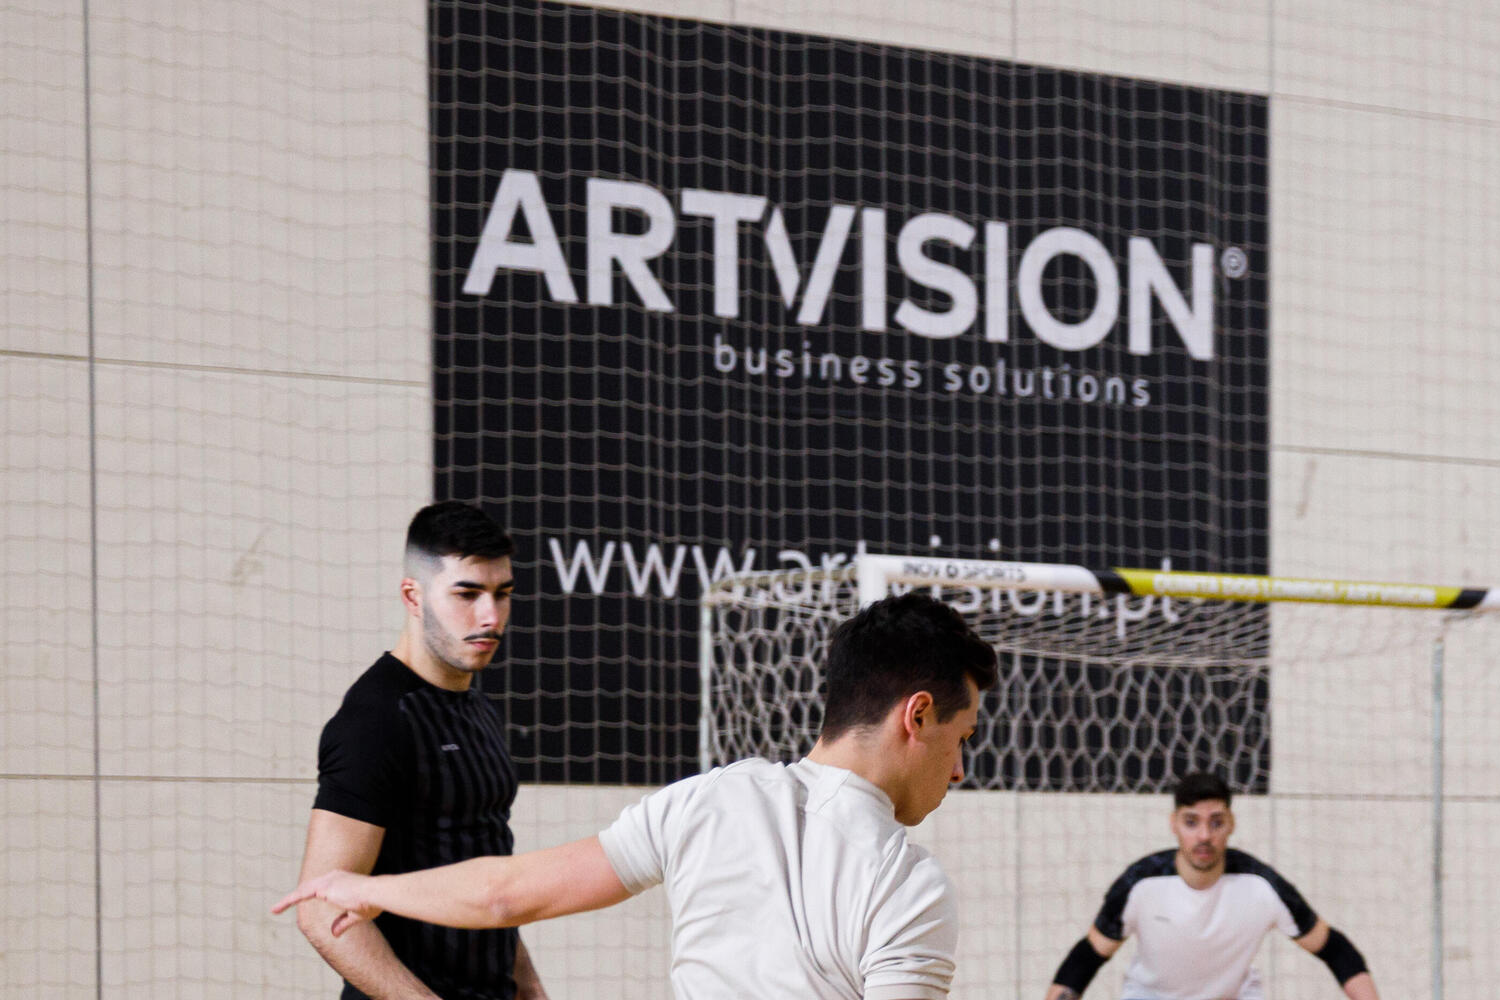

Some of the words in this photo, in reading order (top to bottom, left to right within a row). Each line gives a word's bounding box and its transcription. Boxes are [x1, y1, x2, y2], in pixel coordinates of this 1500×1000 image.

[461, 167, 1215, 361] ARTVISION
[713, 334, 922, 389] business
[944, 359, 1151, 408] solutions
